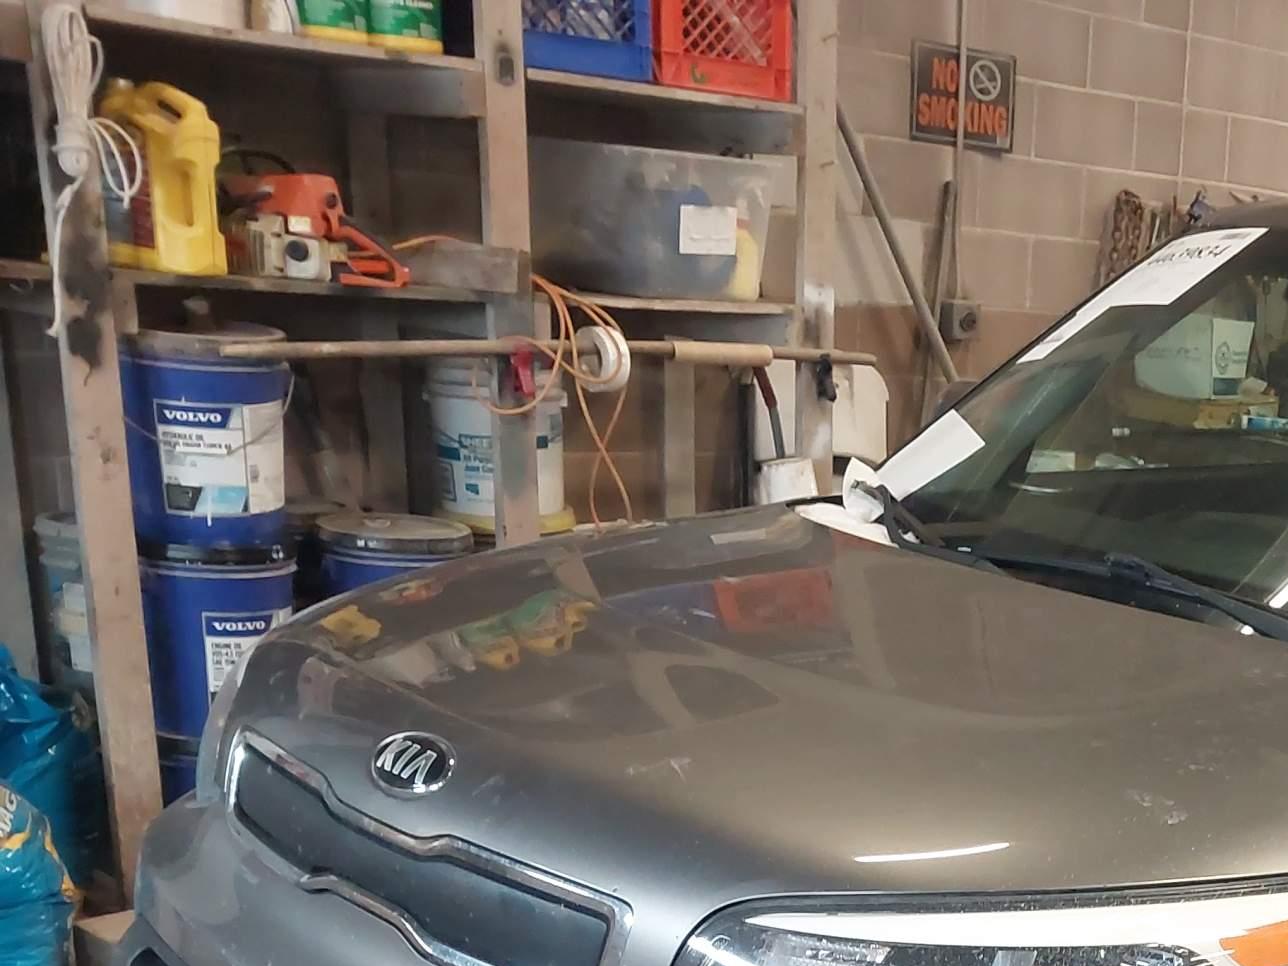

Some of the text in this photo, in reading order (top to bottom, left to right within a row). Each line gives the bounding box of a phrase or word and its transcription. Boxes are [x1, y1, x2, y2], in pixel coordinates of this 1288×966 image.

[931, 56, 960, 93] NO
[163, 409, 222, 423] VOLVO
[212, 621, 266, 632] VOLVO
[376, 739, 437, 785] KIA
